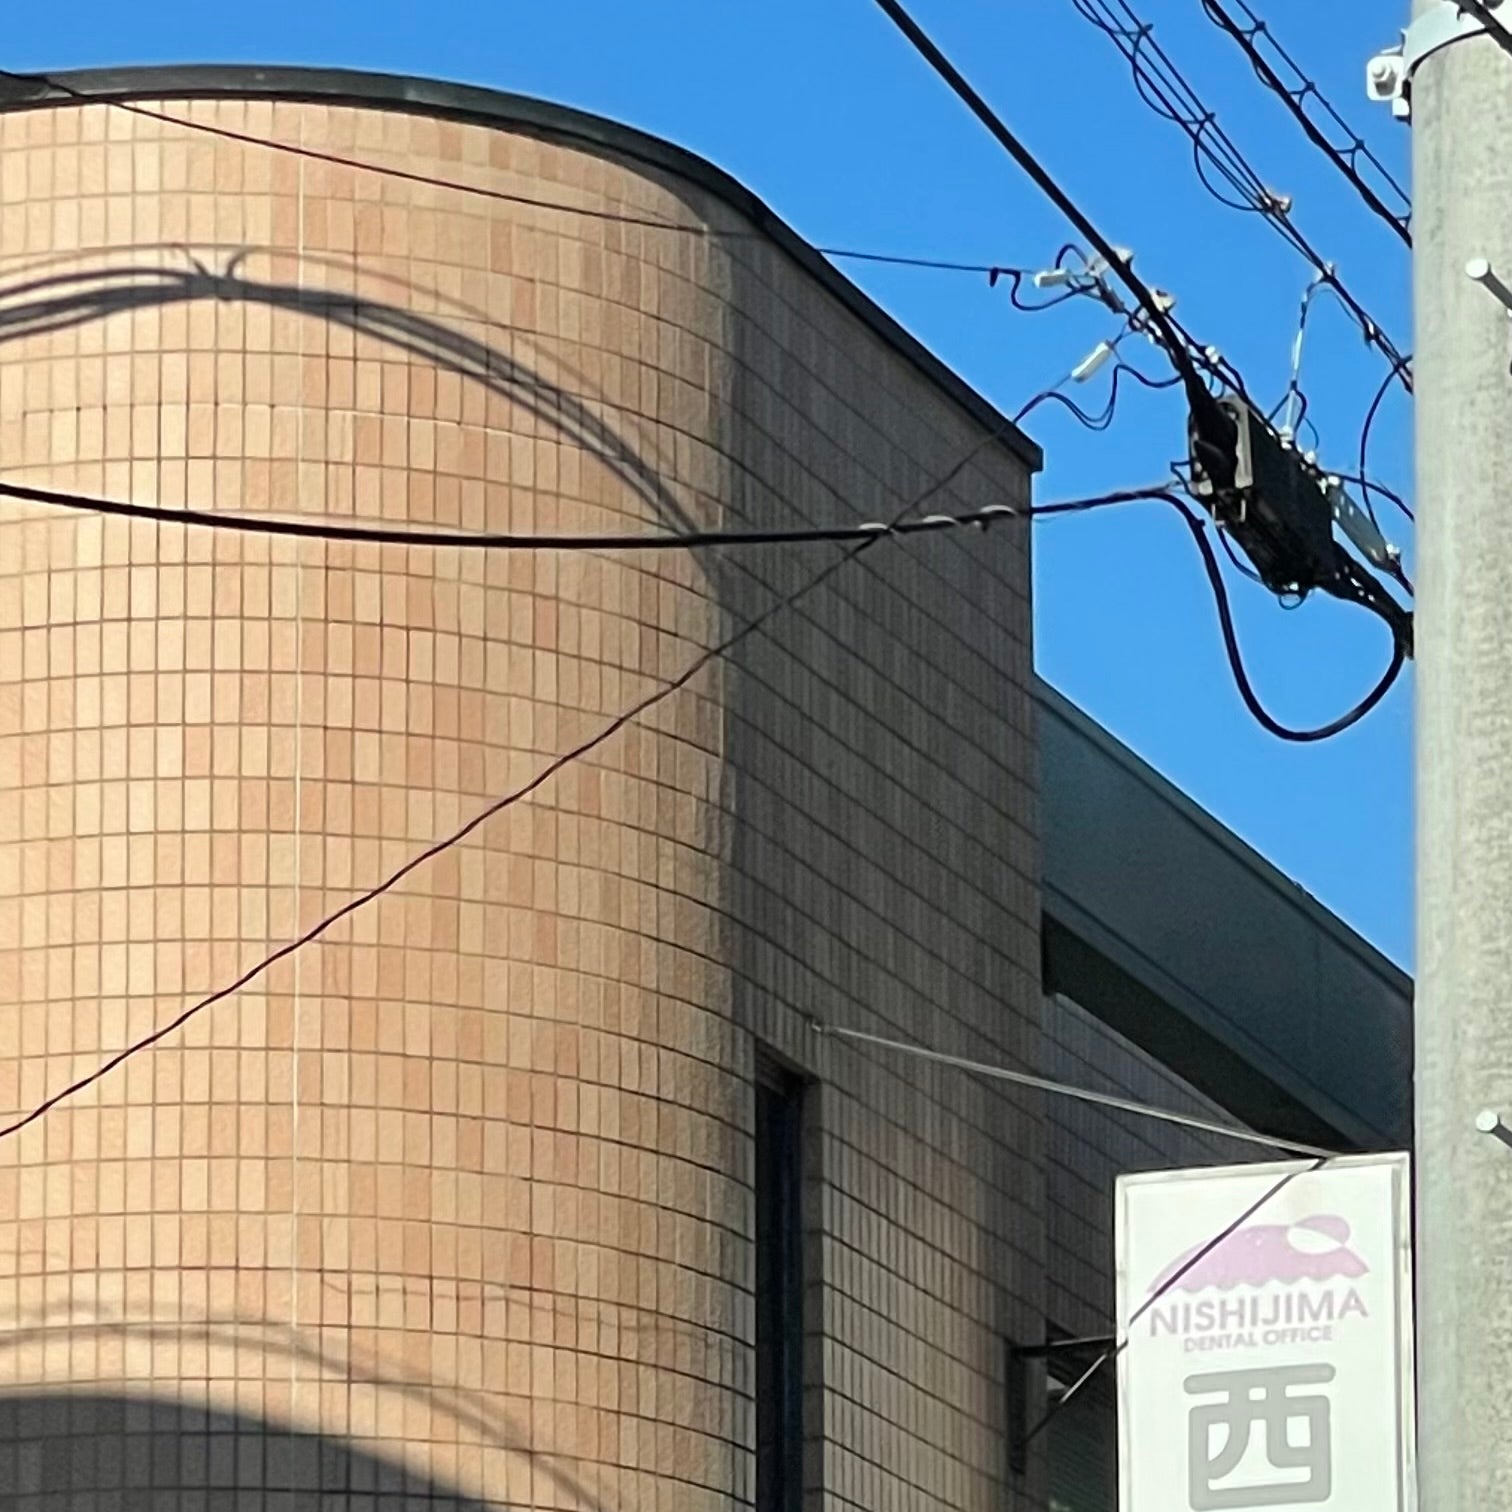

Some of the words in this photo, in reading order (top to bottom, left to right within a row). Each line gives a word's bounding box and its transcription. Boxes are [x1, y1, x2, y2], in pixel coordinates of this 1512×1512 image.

[1150, 1288, 1369, 1337] NISHIJIMA
[1183, 1332, 1258, 1353] DENTAL
[1263, 1325, 1333, 1347] OFFICE
